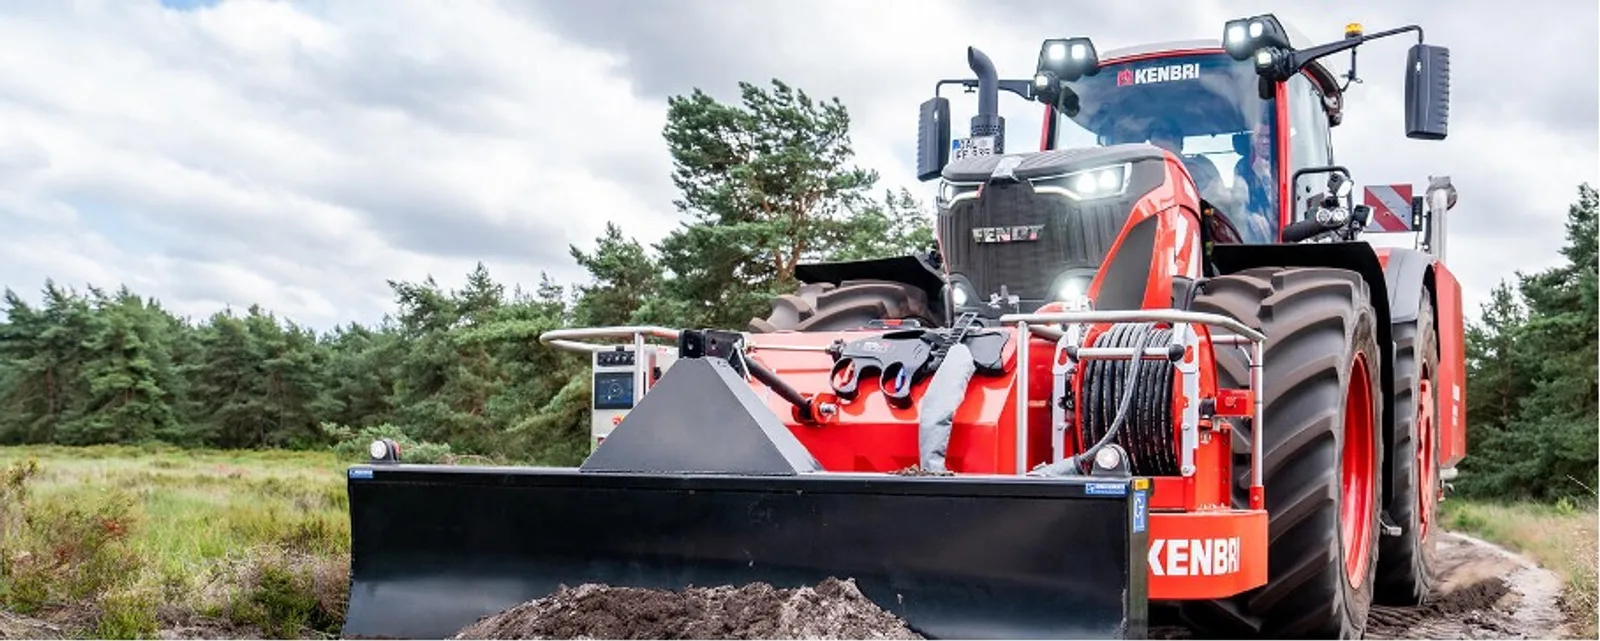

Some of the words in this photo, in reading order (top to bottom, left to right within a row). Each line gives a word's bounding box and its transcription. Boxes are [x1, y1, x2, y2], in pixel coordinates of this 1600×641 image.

[1134, 63, 1200, 84] KENBRI
[972, 224, 1046, 243] FENDT
[1147, 536, 1240, 576] KENBRI
